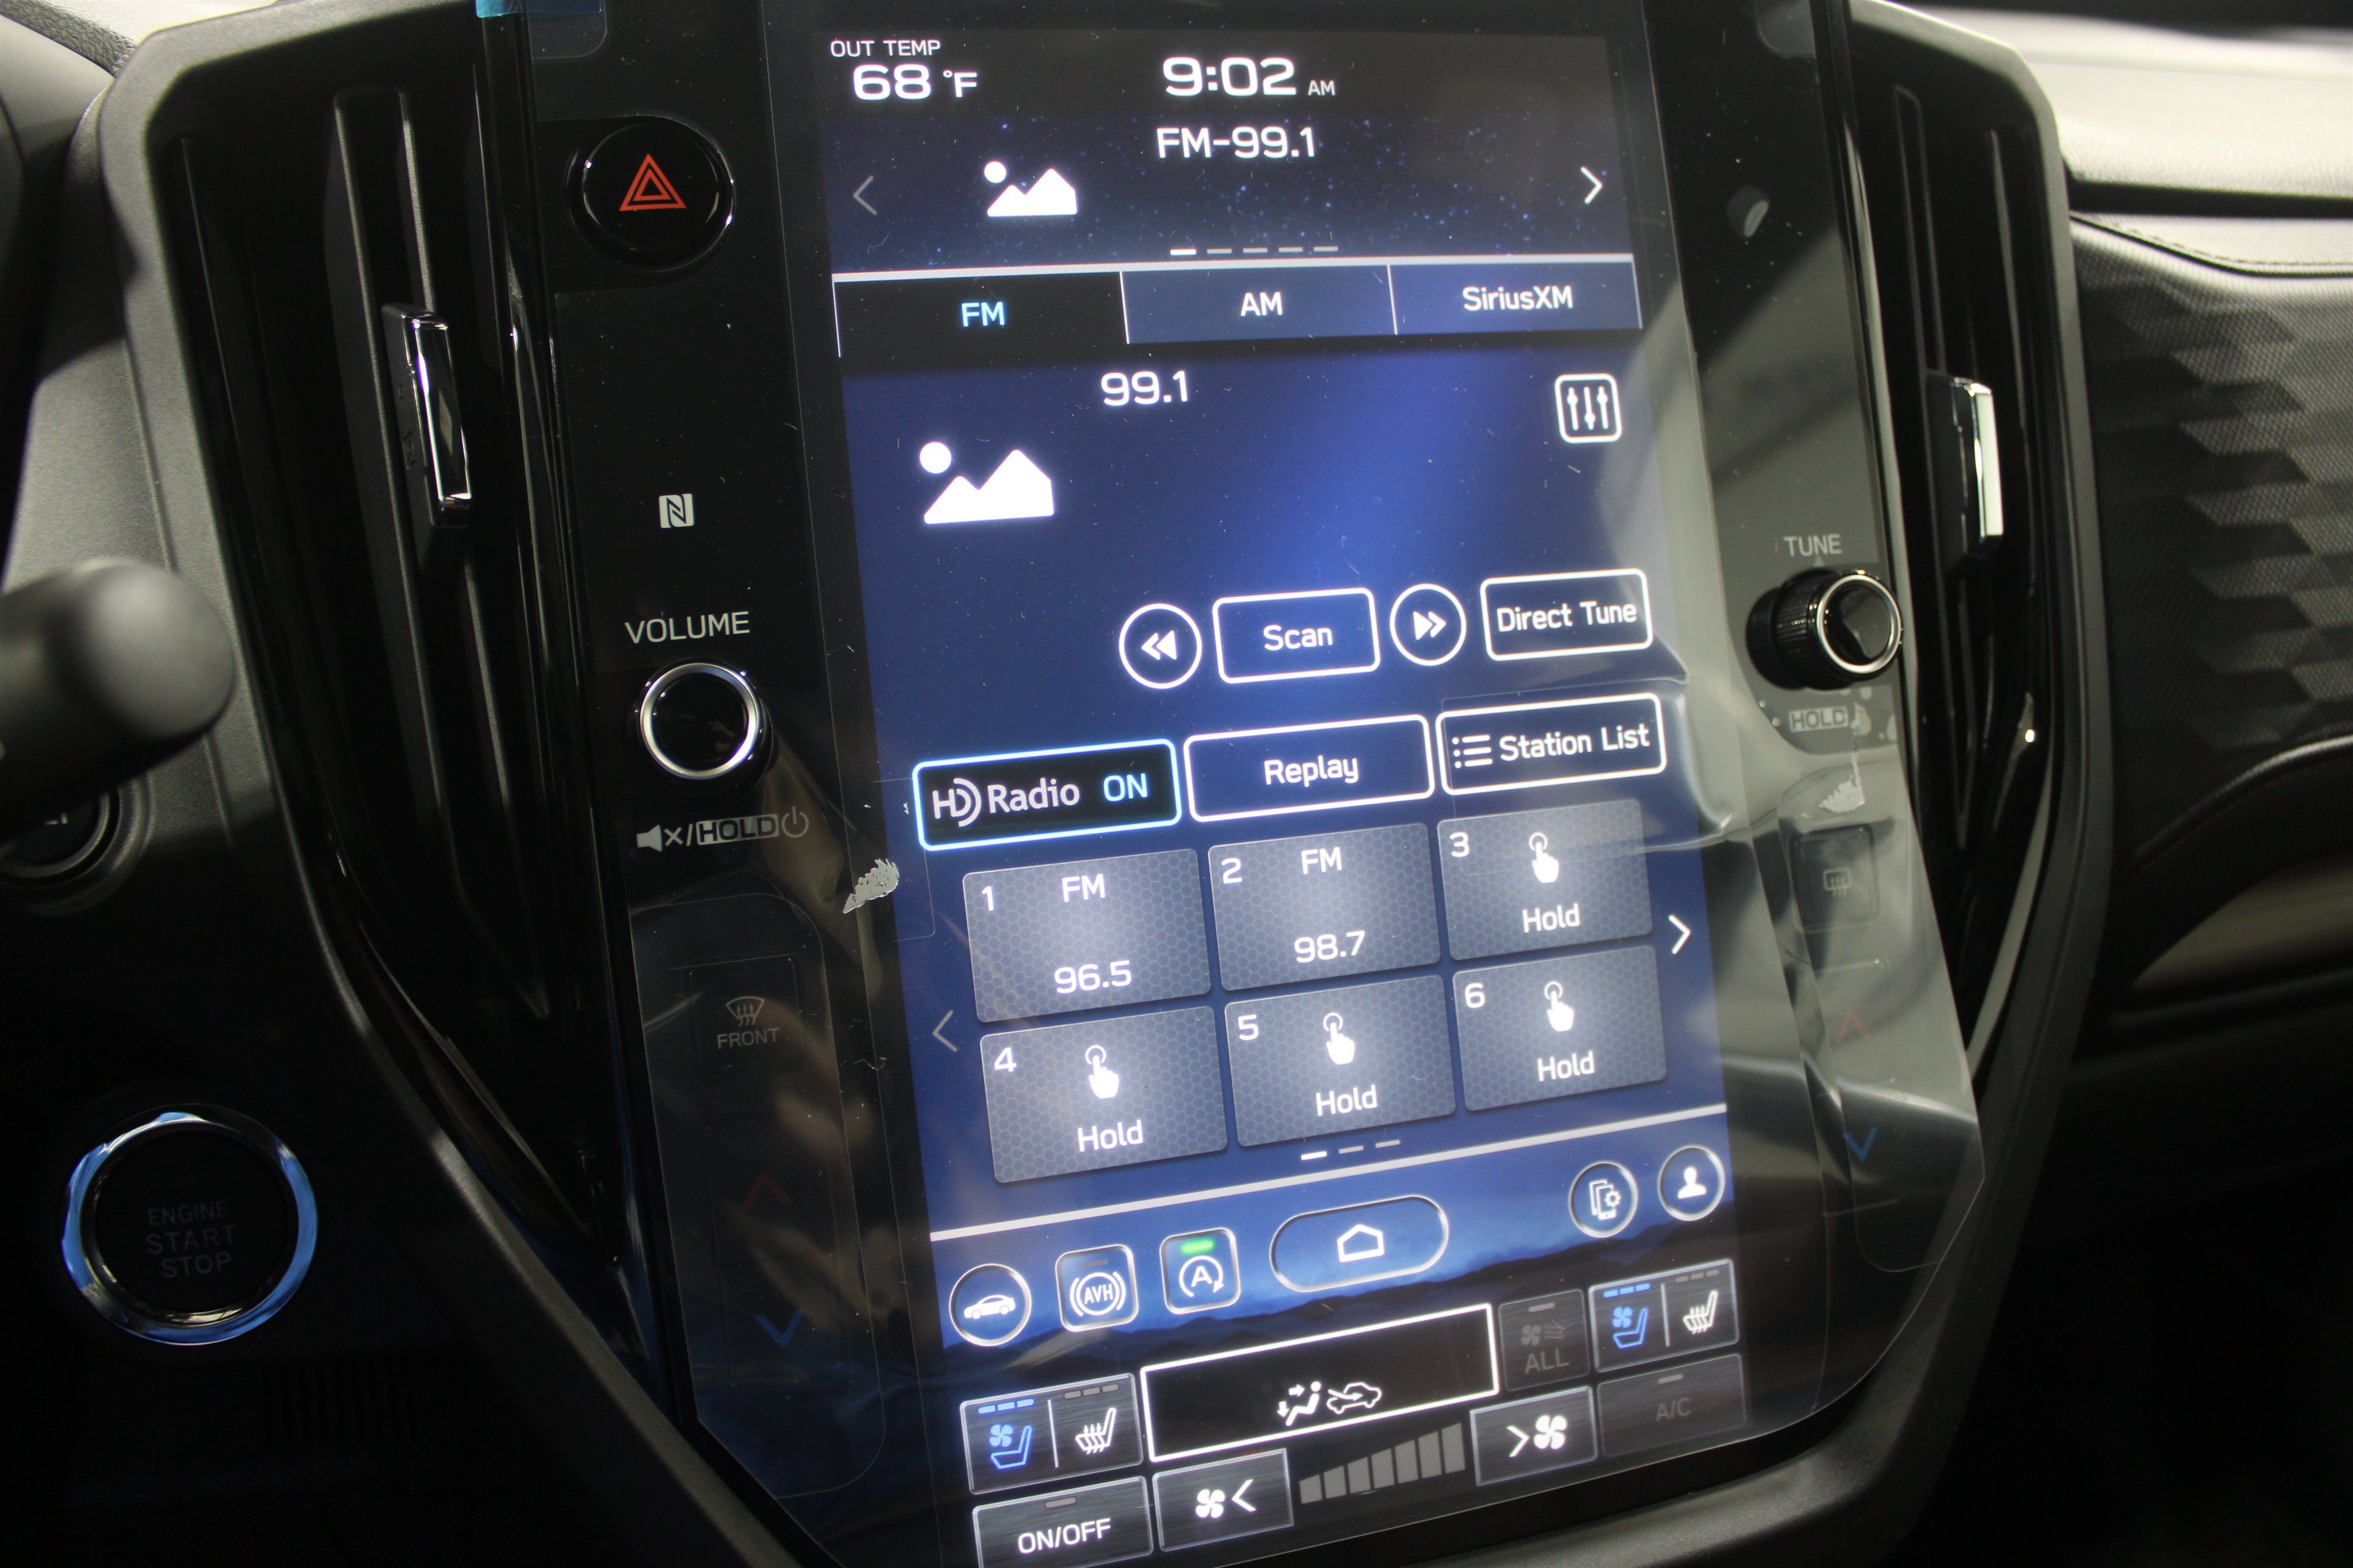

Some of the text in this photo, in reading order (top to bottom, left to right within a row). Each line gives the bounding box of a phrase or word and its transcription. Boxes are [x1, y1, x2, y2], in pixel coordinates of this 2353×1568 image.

[830, 38, 941, 57] OUT TEMP
[853, 63, 932, 101] 68
[1163, 56, 1336, 96] 9:02 AM
[1156, 125, 1315, 159] FM-99.1
[1240, 291, 1283, 317] AM
[1462, 285, 1573, 312] SiriusXM
[960, 301, 1006, 328] FM
[1101, 370, 1188, 407] 99.1
[1784, 534, 1842, 557] TUNE
[624, 611, 750, 644] VOLUME
[1496, 600, 1638, 632] Direct Tune
[1263, 624, 1333, 652] Scan
[1791, 708, 1846, 730] HOLD
[1499, 723, 1650, 762] Station List
[1264, 755, 1359, 788] Replay
[987, 777, 1080, 814] Radio
[1102, 773, 1150, 804] ON
[1449, 832, 1469, 858] 3
[1221, 858, 1243, 885] 2
[1301, 847, 1342, 875] FM
[981, 885, 996, 912] 1
[1062, 873, 1108, 903] FM
[1522, 903, 1580, 933] Hold
[1294, 930, 1365, 964] 98.7
[1054, 959, 1132, 995] 96.5
[1464, 983, 1486, 1009] 6
[717, 1027, 780, 1049] FRONT
[1237, 1014, 1259, 1041] 5
[993, 1046, 1017, 1073] 4
[1537, 1051, 1595, 1082] Hold
[1316, 1084, 1378, 1117] Hold
[1077, 1119, 1144, 1153] Hold
[147, 1200, 230, 1227] ENGINE
[146, 1223, 236, 1254] START
[161, 1252, 231, 1279] STOP
[1191, 1265, 1213, 1287] A
[1084, 1284, 1114, 1304] AVH
[1525, 1349, 1569, 1374] ALL
[1656, 1397, 1692, 1422] A/C
[1017, 1517, 1111, 1554] ON/OFF
